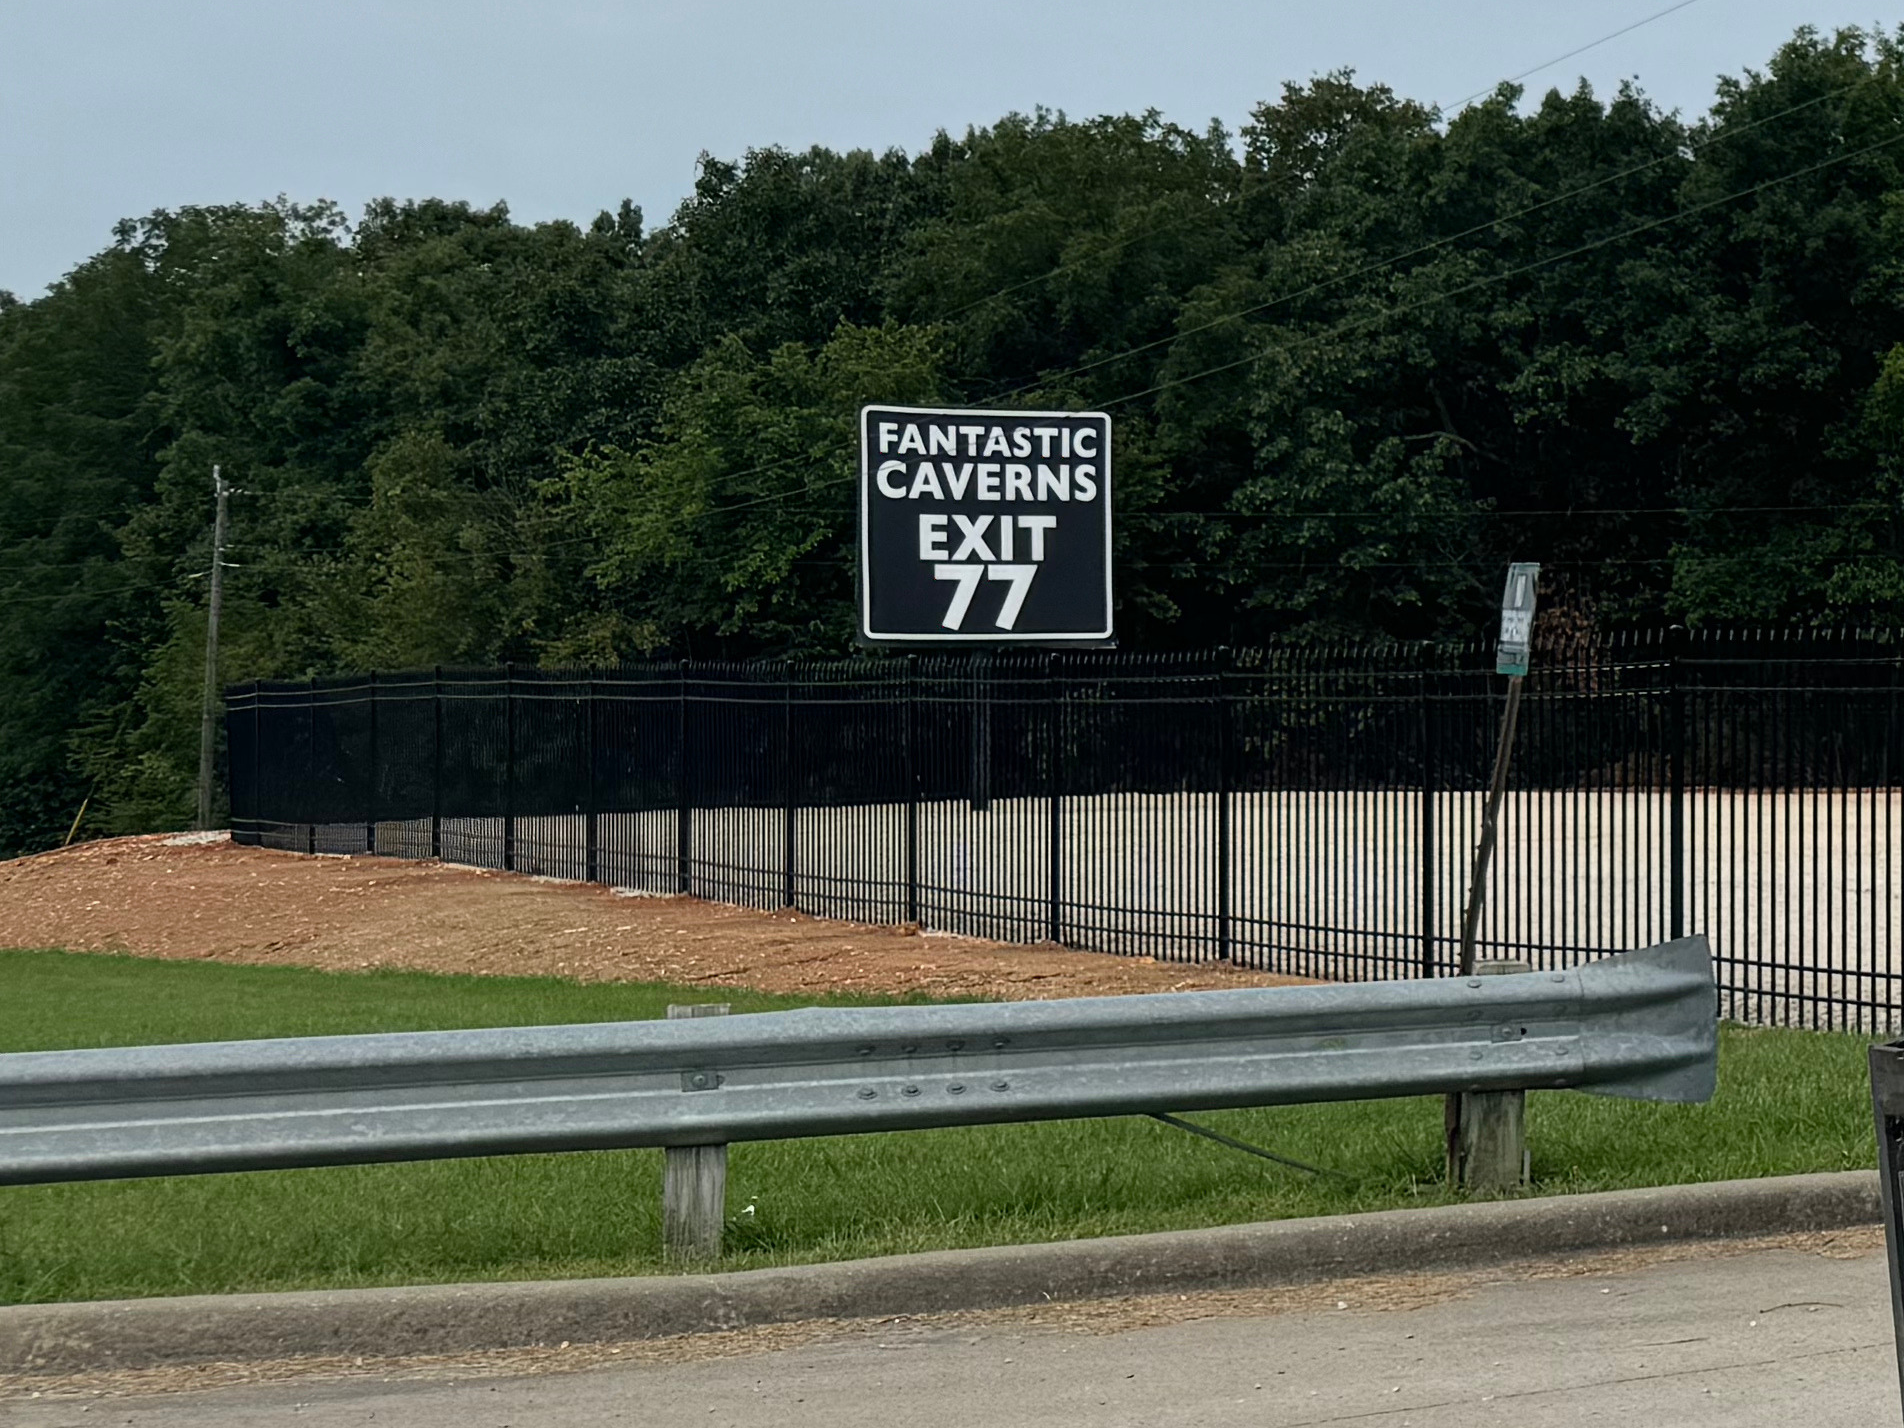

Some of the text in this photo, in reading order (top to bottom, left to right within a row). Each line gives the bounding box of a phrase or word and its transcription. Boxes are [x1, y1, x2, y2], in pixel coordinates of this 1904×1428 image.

[879, 422, 1097, 458] FANTASTIC
[876, 460, 1097, 502] CAVERNS
[919, 514, 1057, 561] EXIT
[934, 564, 1038, 630] 77
